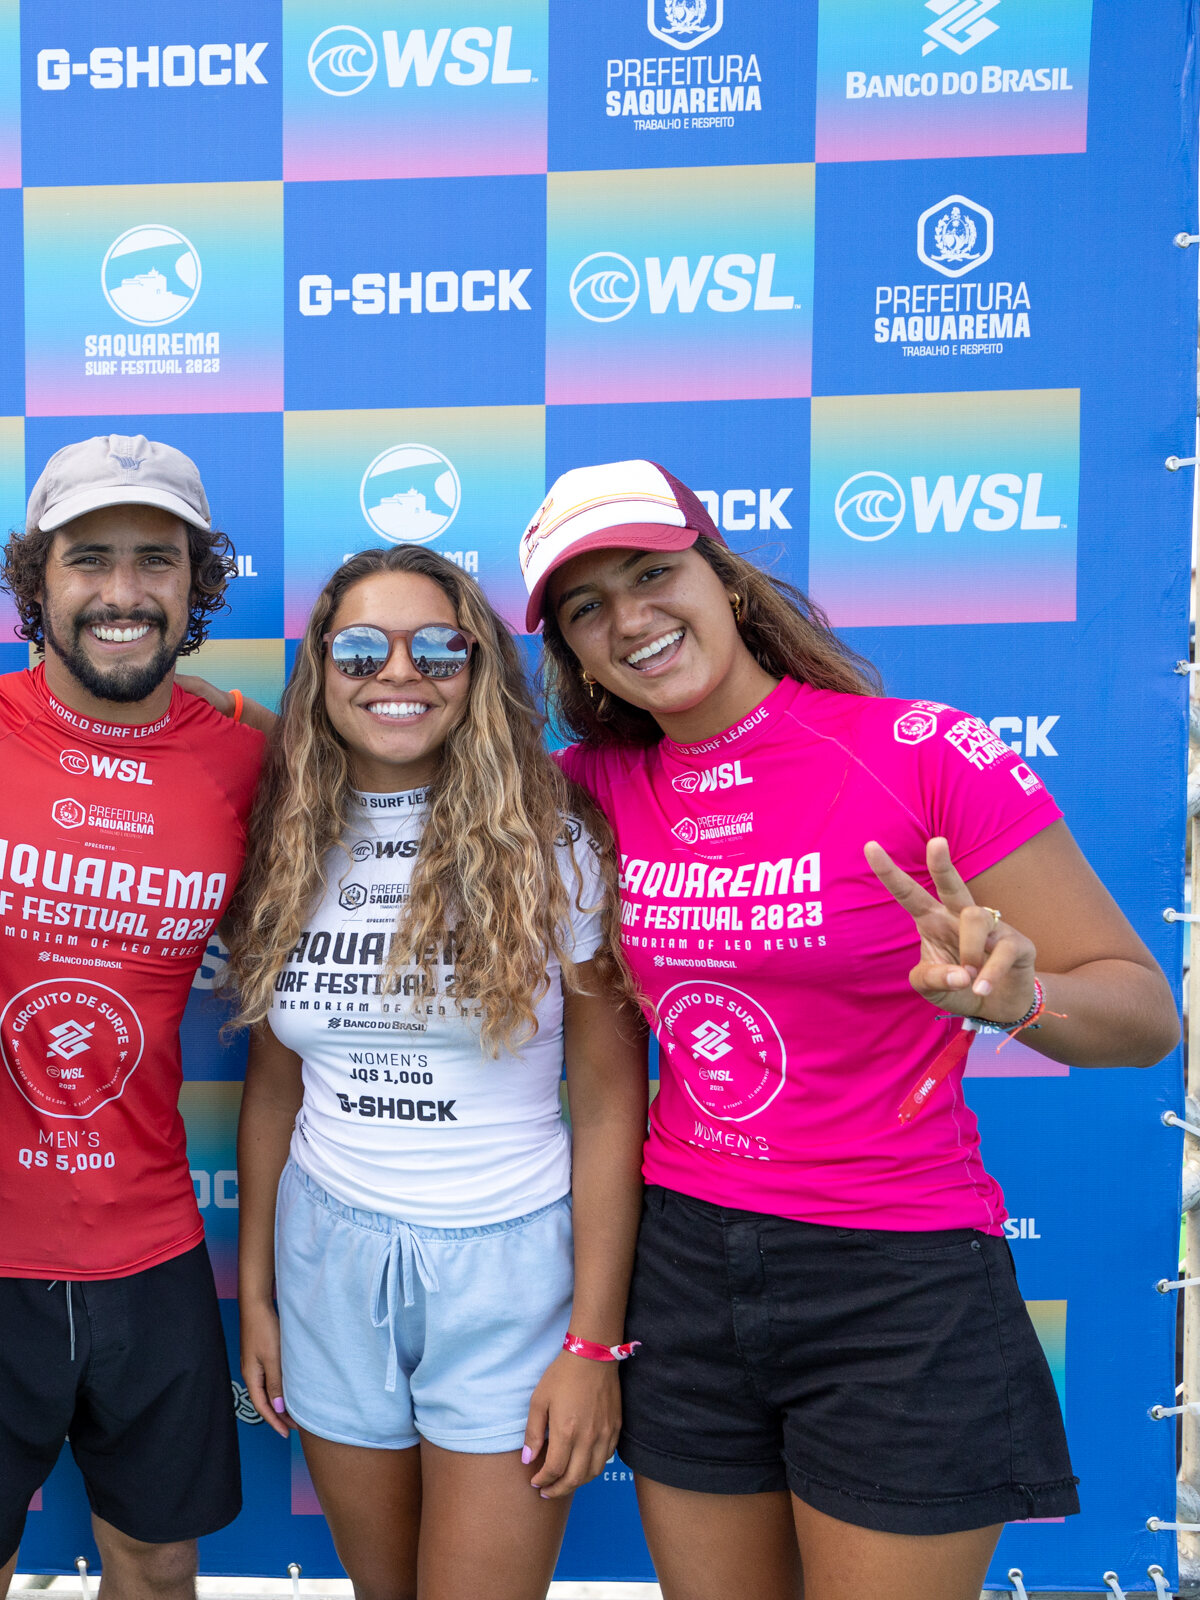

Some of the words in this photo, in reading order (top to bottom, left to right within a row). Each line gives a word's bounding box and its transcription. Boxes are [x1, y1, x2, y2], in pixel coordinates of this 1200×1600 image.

[38, 43, 268, 90] G-SHOCK
[383, 26, 531, 88] WSL
[607, 54, 761, 88] PREFEITURA
[846, 72, 938, 99] BANCO
[942, 71, 977, 95] DO
[982, 66, 1073, 93] BRASIL
[606, 86, 761, 116] SAQUAREMA
[634, 119, 681, 130] TRABALHO
[684, 118, 689, 128] E
[692, 117, 734, 128] RESPEITO
[300, 269, 532, 316] G-SHOCK
[645, 253, 794, 314] WSL
[876, 282, 1030, 314] PREFEITURA
[875, 313, 1030, 342] SAQUAREMA
[85, 333, 219, 357] SAQUAREMA
[902, 345, 949, 356] TRABALHO
[960, 343, 1003, 354] RESPEITO
[86, 361, 117, 375] SURF
[121, 360, 182, 375] FESTIVAL
[186, 358, 219, 373] 2023
[911, 473, 1060, 533] WSL
[49, 696, 90, 730] WORLD
[91, 722, 131, 738] SURF
[133, 712, 171, 738] LEAGUE
[691, 739, 722, 755] SURF
[723, 707, 770, 743] LEAGUE
[91, 754, 153, 785] WSL
[699, 760, 754, 793] WSL
[89, 804, 155, 825] PREFEITURA
[370, 797, 405, 808] SURF
[88, 815, 154, 835] SAQUAREMA
[697, 811, 754, 828] PREFEITURA
[700, 821, 753, 840] SAQUAREMA
[22, 895, 148, 938] FESTIVAL
[156, 917, 215, 942] 2023
[644, 904, 743, 931] FESTIVAL
[751, 901, 824, 931] 2023
[91, 937, 109, 949] OF
[121, 943, 150, 955] LEO
[160, 946, 199, 957] NEVES
[698, 939, 714, 950] OF
[725, 939, 752, 951] LEO
[764, 935, 827, 951] NEVES
[52, 953, 82, 966] BANCO
[94, 958, 123, 970] BRASIL
[666, 956, 695, 967] BANCO
[707, 958, 738, 968] BRASIL
[12, 991, 72, 1033] CIRCUITO
[75, 992, 99, 1008] DE
[97, 1002, 130, 1045] SURFE
[280, 1000, 369, 1012] MEMORIAM
[704, 992, 724, 1008] DE
[726, 1000, 765, 1045] SURFE
[343, 1019, 377, 1029] BANCO
[392, 1021, 427, 1032] BRASIL
[58, 1082, 76, 1090] 2023
[60, 1067, 85, 1080] WSL
[349, 1068, 379, 1083] JQS
[384, 1070, 433, 1085] 1,000
[707, 1070, 734, 1082] WSL
[919, 1077, 937, 1096] WSL
[336, 1092, 458, 1122] G-SHOCK
[18, 1148, 48, 1169] QS
[55, 1151, 116, 1174] 5,000
